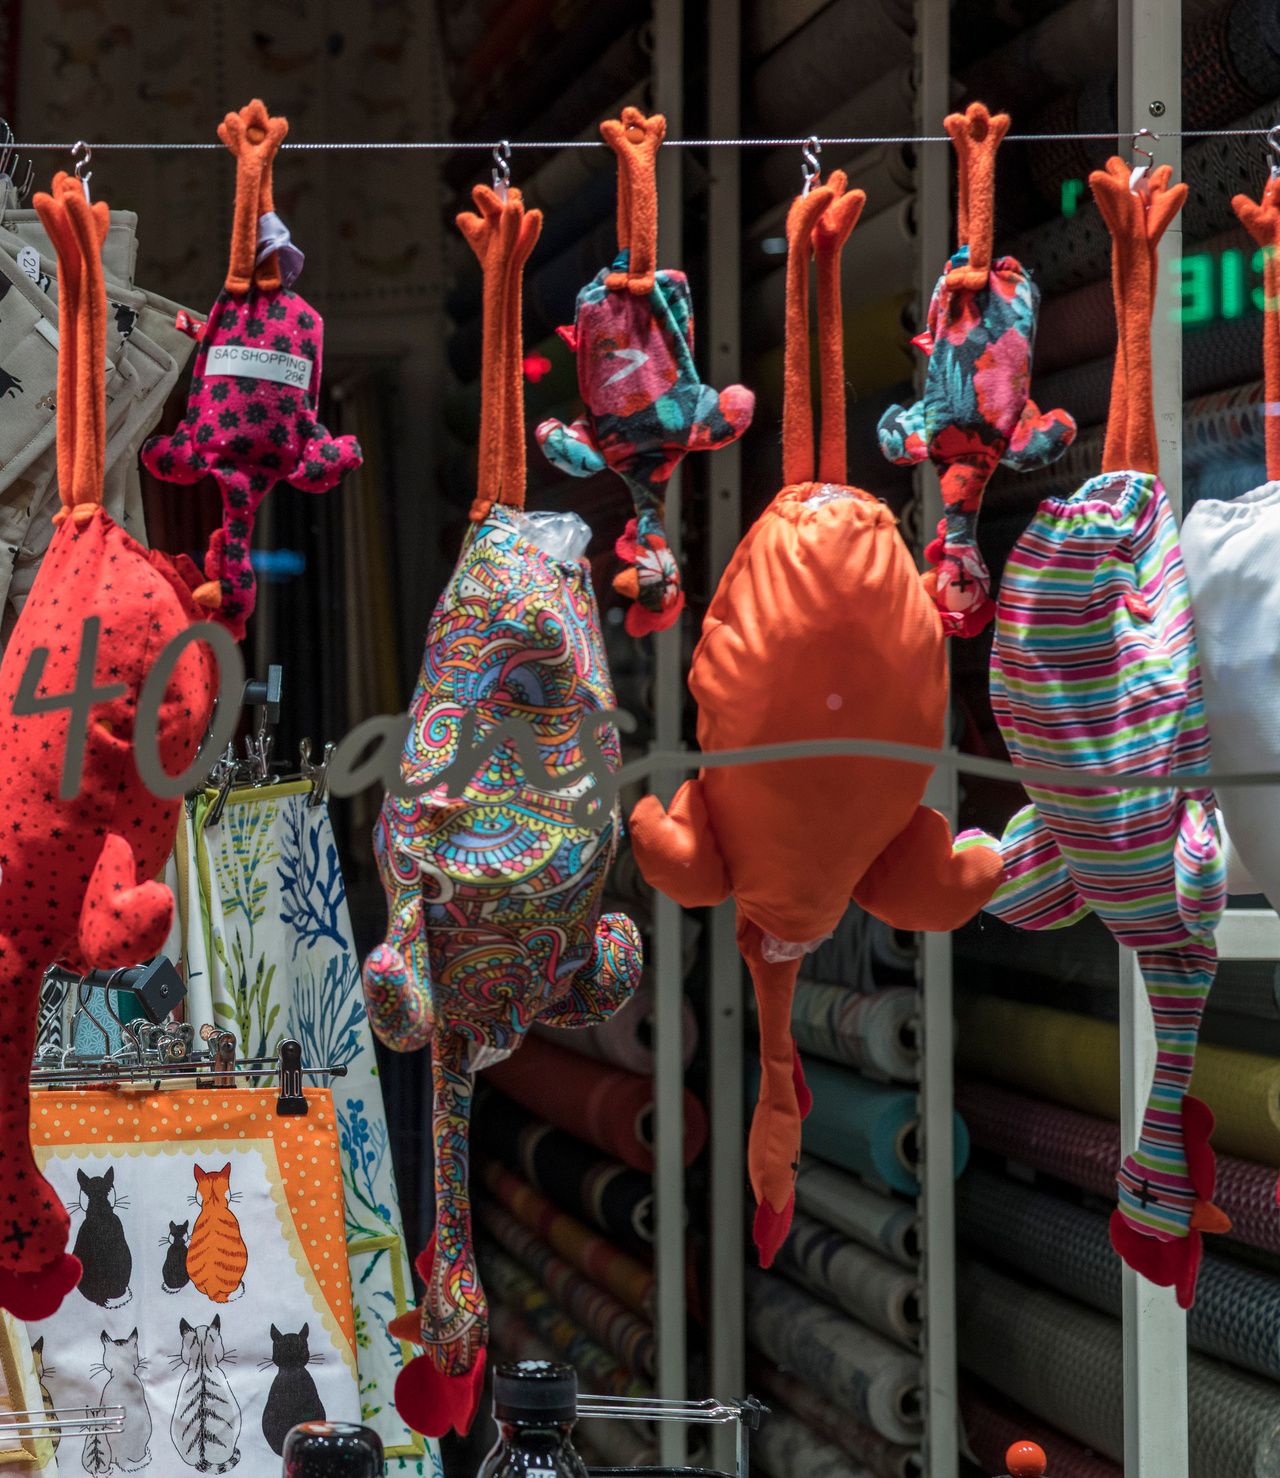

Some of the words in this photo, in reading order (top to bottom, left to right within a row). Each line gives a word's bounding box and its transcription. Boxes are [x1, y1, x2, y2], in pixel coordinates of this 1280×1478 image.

[214, 349, 238, 359] SAC
[241, 350, 307, 372] SHOPPING
[284, 369, 306, 385] 28€
[12, 615, 246, 800] 40
[327, 707, 638, 829] ans
